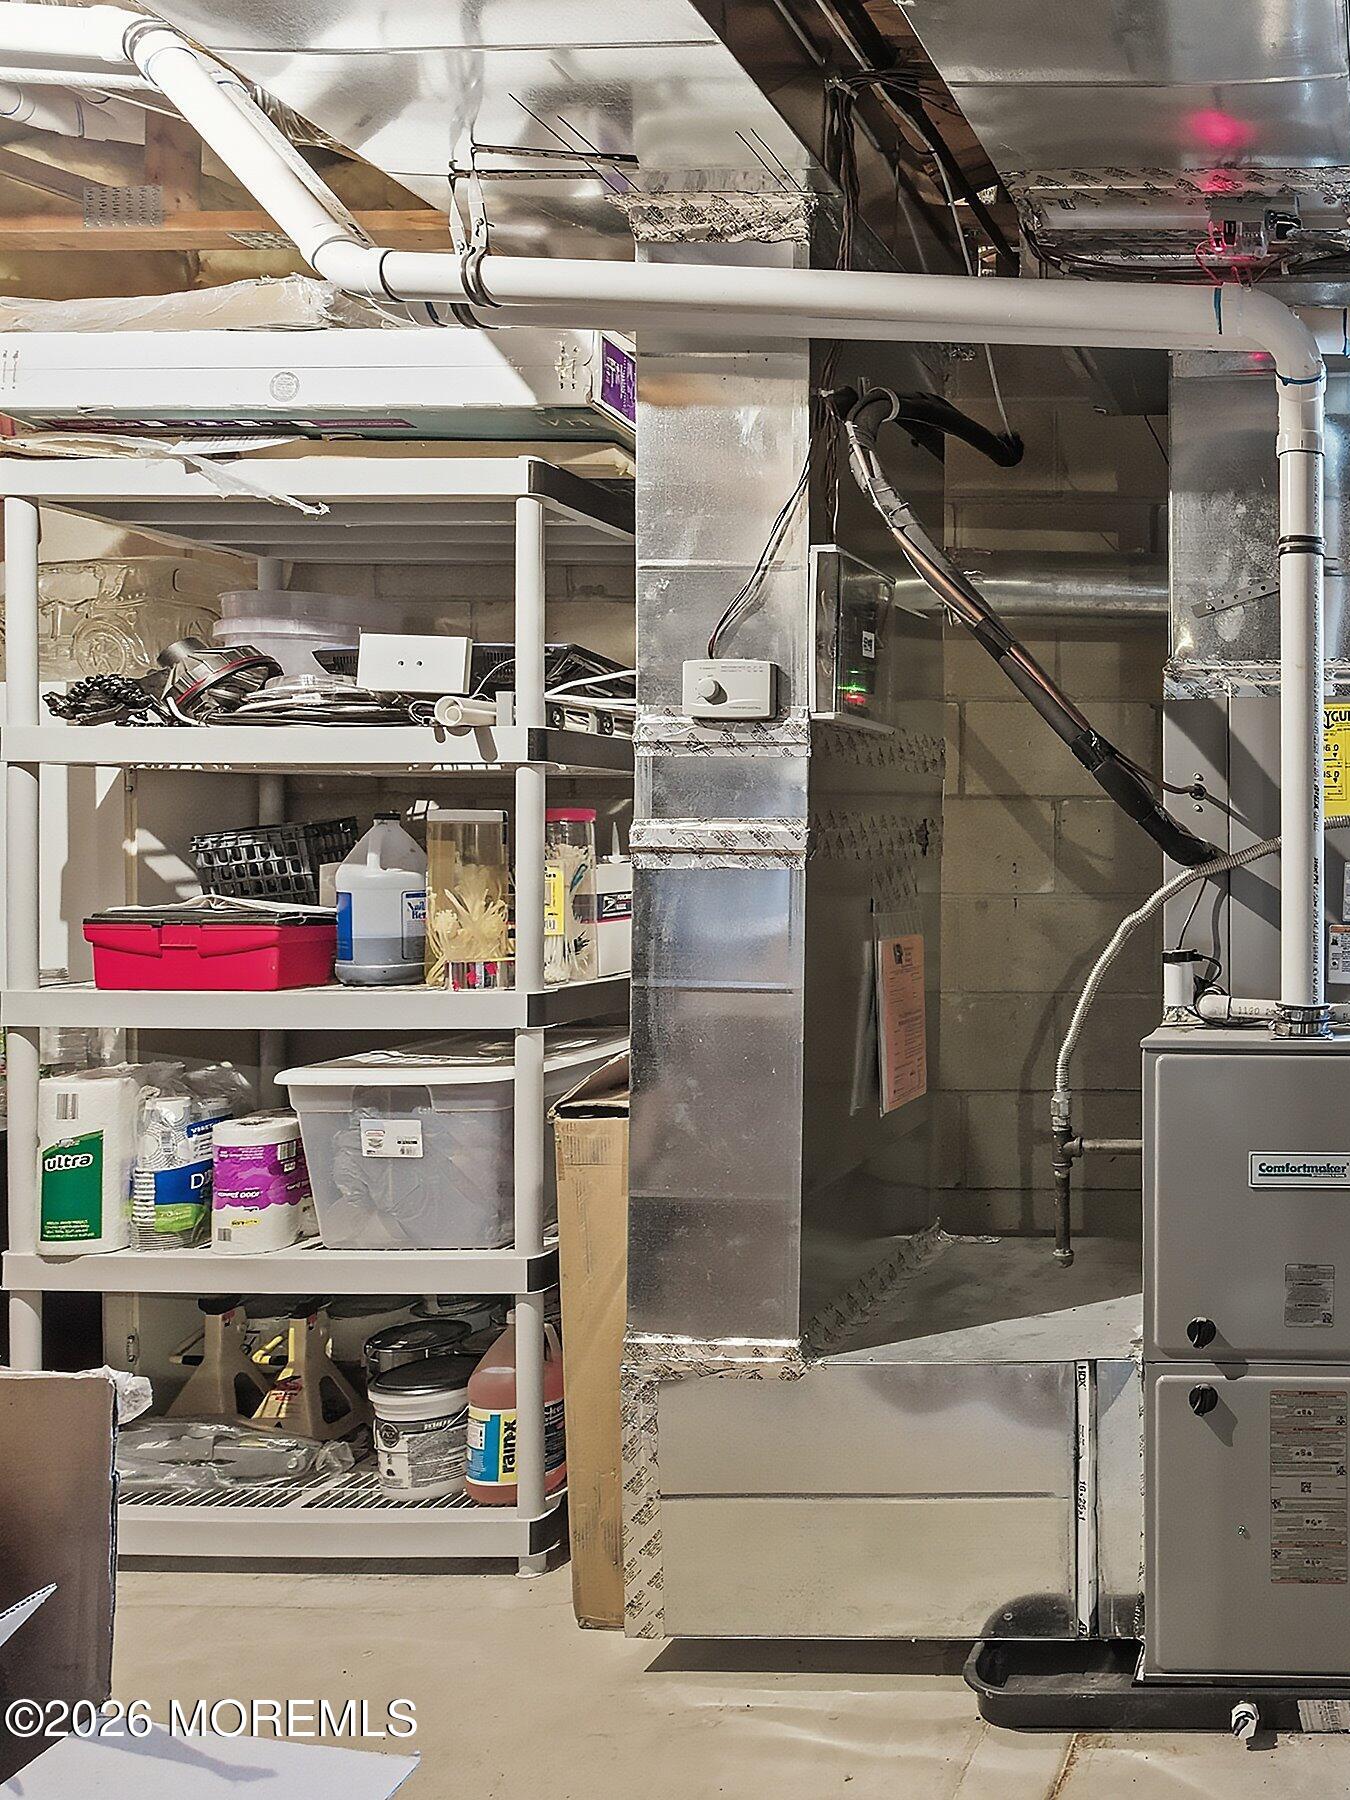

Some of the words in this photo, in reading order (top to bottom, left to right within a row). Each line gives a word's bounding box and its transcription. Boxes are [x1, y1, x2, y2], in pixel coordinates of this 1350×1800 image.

[46, 1154, 92, 1170] ultra
[1258, 1162, 1347, 1173] Comfortmaker
[1077, 1365, 1087, 1387] HDX
